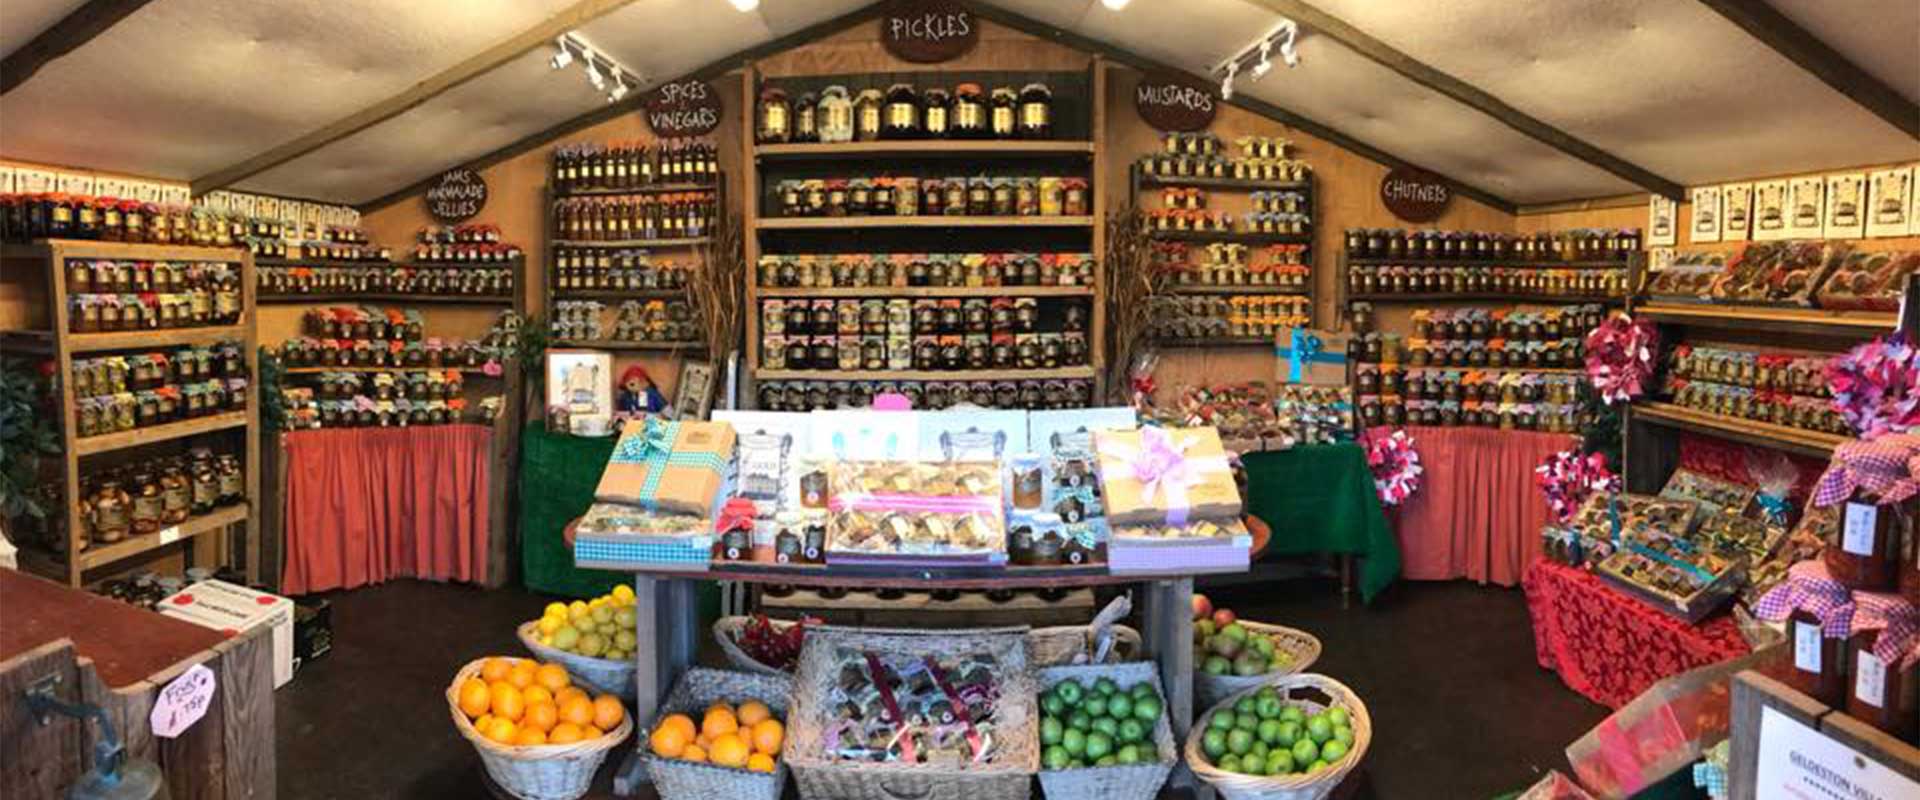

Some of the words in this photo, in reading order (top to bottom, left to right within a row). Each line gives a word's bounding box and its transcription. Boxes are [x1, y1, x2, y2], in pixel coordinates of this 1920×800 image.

[891, 13, 969, 40] PICKLES
[660, 81, 706, 103] SPICES
[1137, 84, 1212, 112] MUSTARDS
[649, 108, 717, 131] VINEGARS
[442, 170, 471, 186] JAMS
[433, 200, 476, 217] JELLIES
[1790, 750, 1850, 791] GELDESTON
[1854, 783, 1884, 800] VILL
